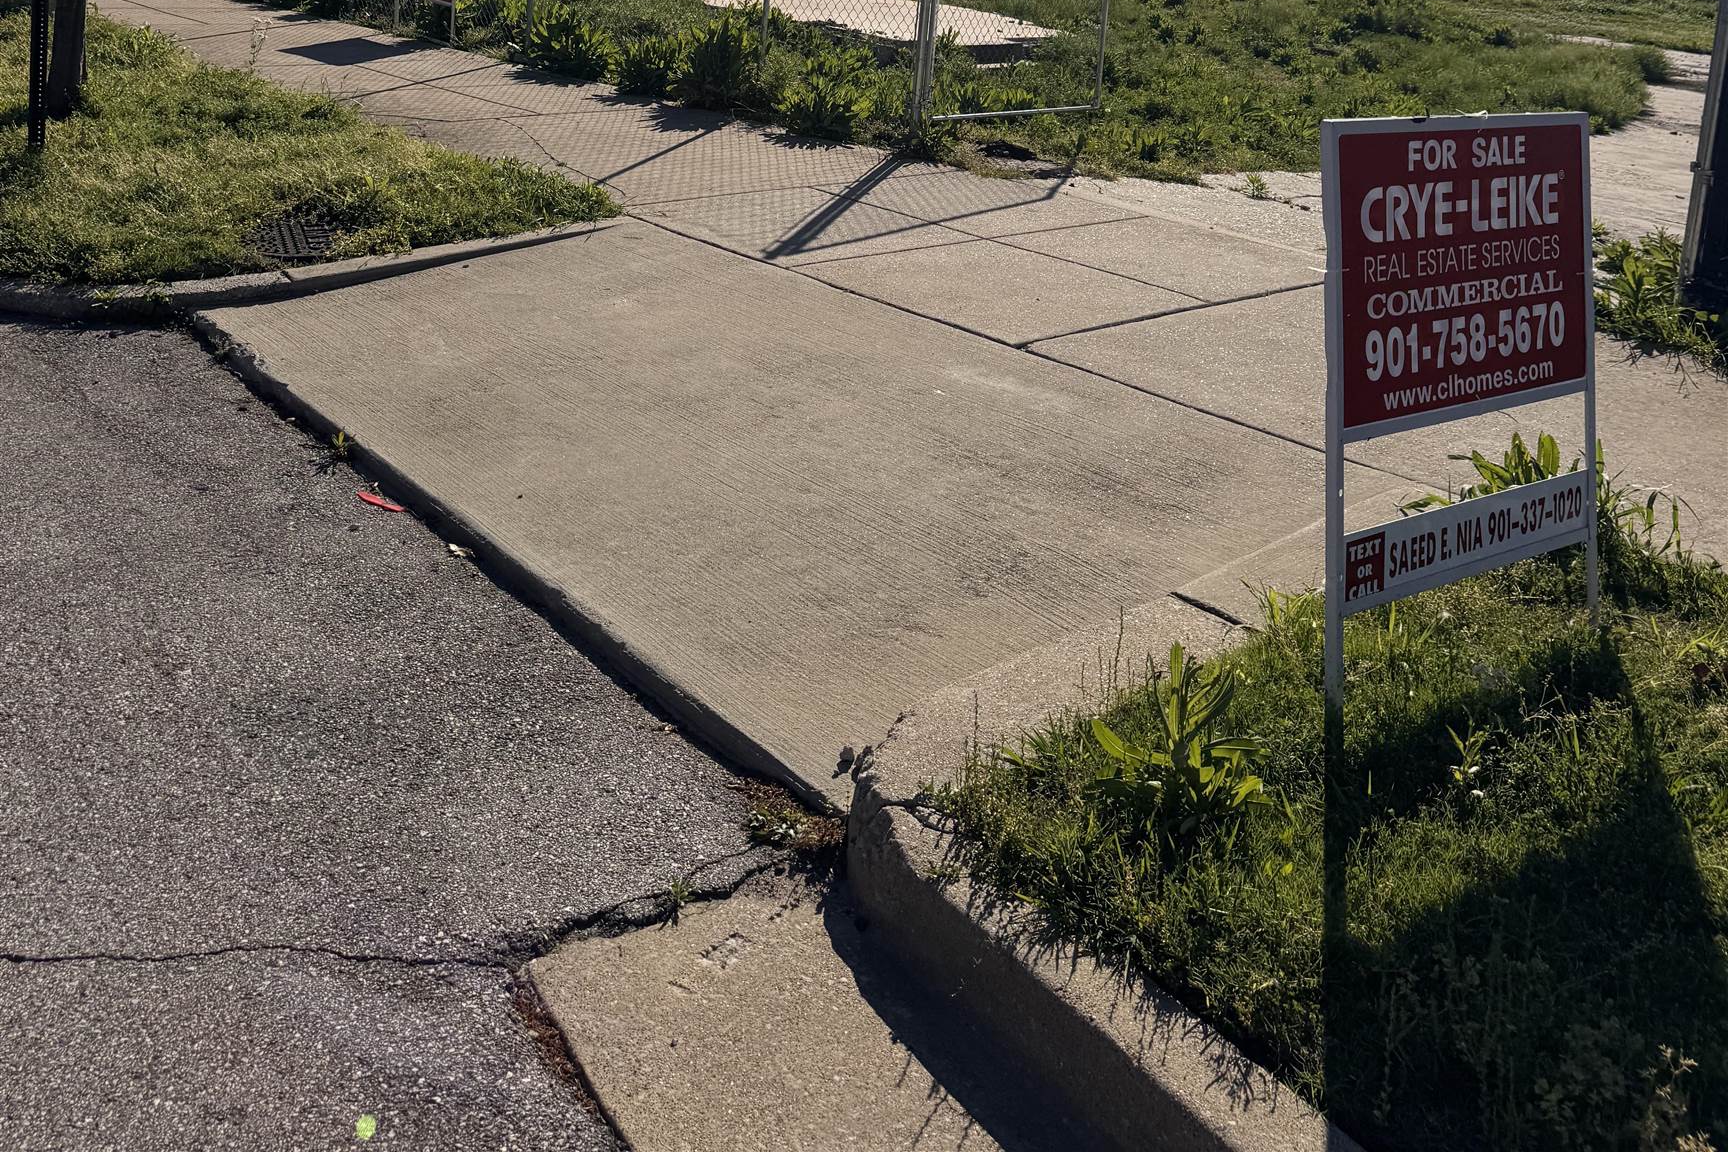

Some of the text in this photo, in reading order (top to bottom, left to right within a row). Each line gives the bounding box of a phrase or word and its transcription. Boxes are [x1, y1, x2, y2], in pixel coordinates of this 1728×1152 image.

[1407, 135, 1526, 171] FOR SALE
[1360, 172, 1559, 243] CRYE-LEIKE
[1364, 235, 1560, 284] REAL ESTATE SERVICES
[1367, 270, 1563, 319] COMMERCIAL
[1365, 301, 1565, 382] 901-758-5670
[1384, 359, 1554, 411] www.clhomes.com
[1348, 538, 1382, 562] TEXT
[1388, 485, 1582, 578] SAEED E. NIA 901-337-1020
[1348, 579, 1380, 601] CALL
[1357, 563, 1373, 579] OR
